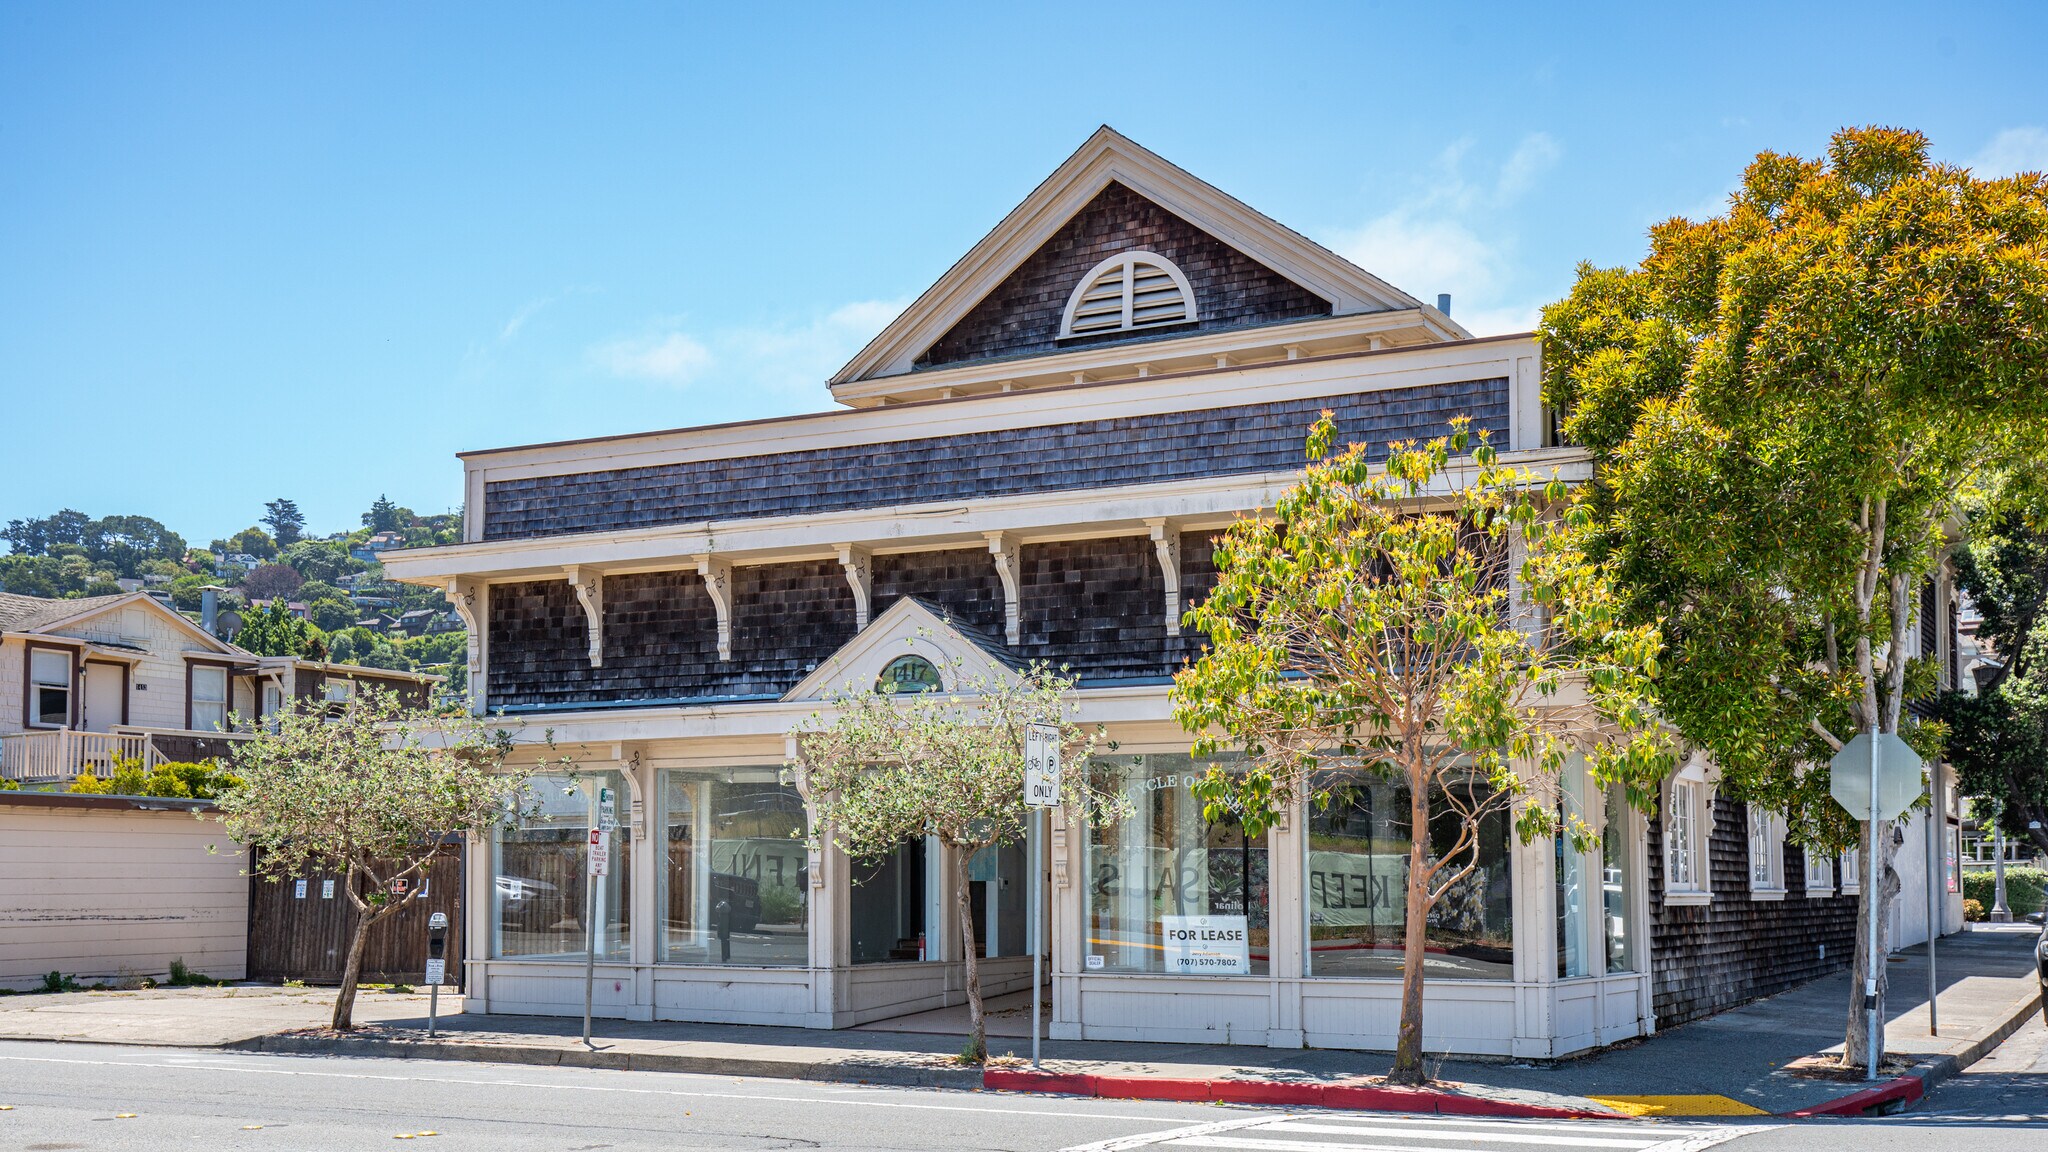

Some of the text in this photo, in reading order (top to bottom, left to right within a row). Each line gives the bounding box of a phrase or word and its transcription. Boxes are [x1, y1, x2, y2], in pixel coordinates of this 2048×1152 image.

[892, 663, 928, 682] 1417
[1033, 785, 1053, 798] ONLY
[1127, 774, 1178, 800] CYCLE
[592, 832, 599, 843] NO
[1169, 929, 1243, 941] FOR LEASE
[1177, 958, 1198, 966] (707)
